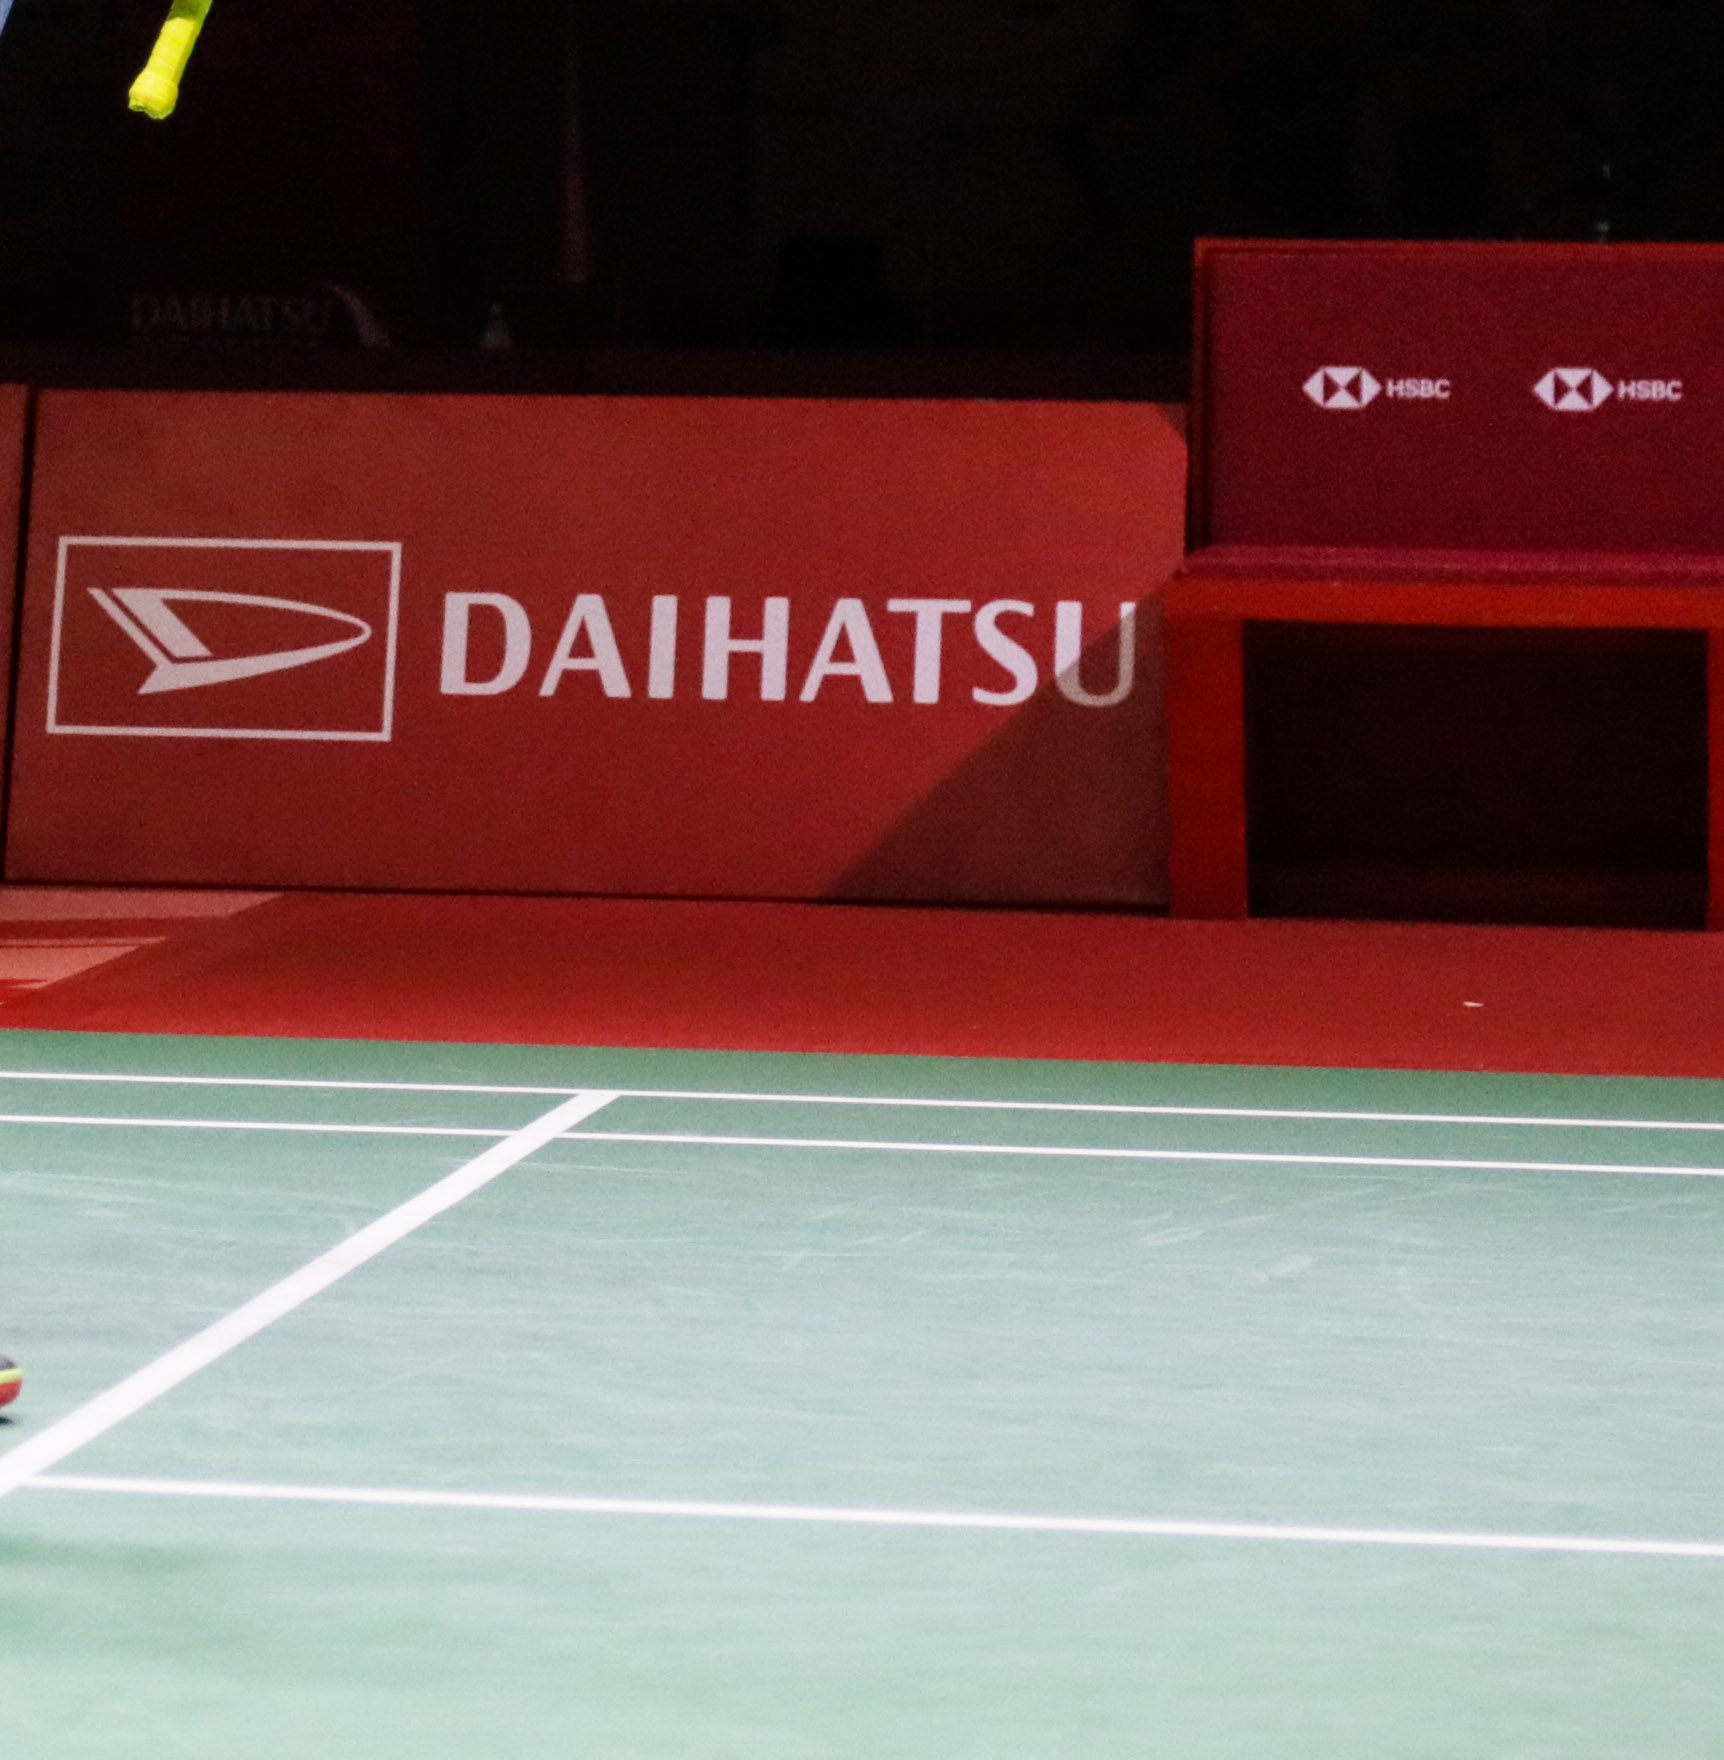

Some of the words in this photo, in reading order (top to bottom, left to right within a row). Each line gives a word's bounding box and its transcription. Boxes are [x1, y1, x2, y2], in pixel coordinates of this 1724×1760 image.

[1386, 378, 1451, 400] HSBC
[1618, 379, 1684, 402] HSBC
[438, 589, 1138, 708] DAIHATSU
